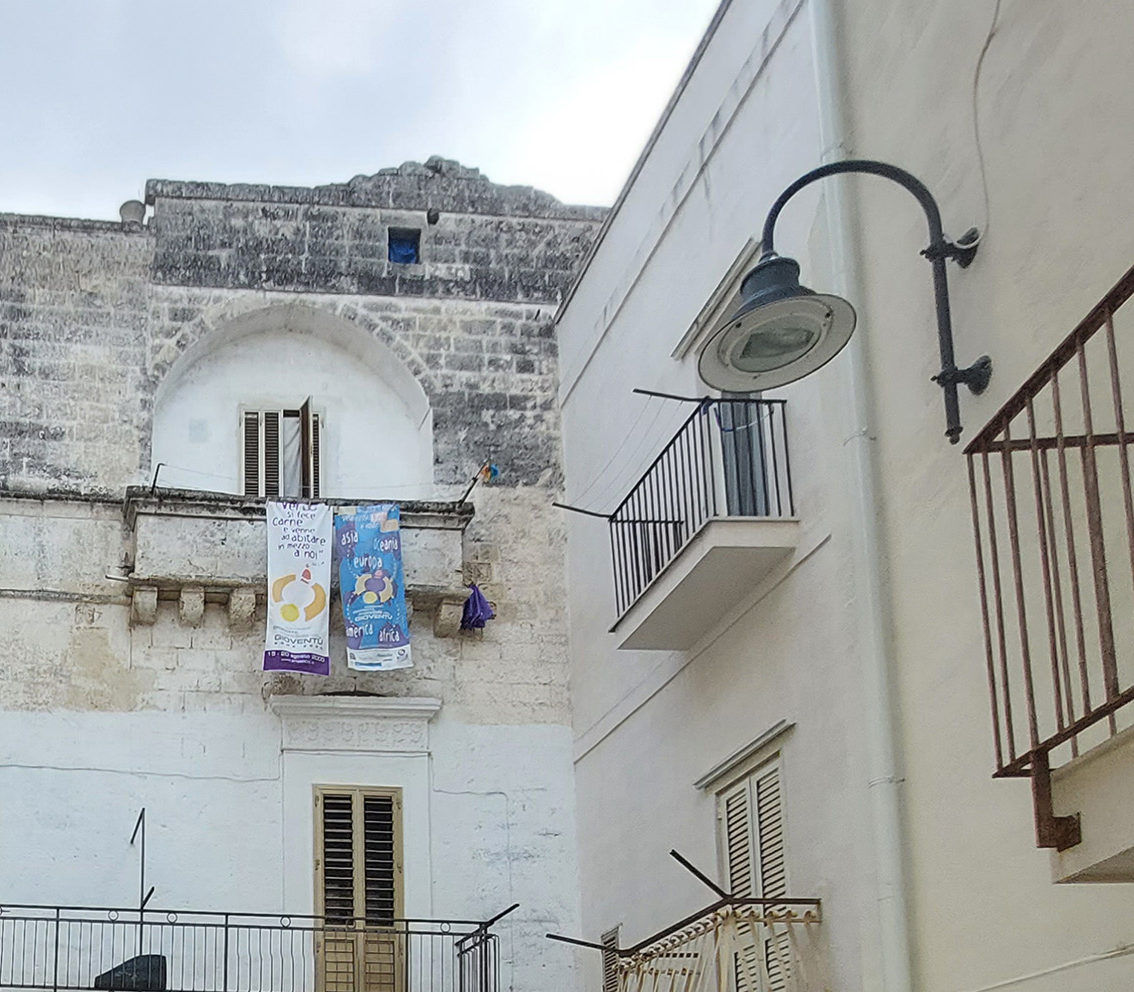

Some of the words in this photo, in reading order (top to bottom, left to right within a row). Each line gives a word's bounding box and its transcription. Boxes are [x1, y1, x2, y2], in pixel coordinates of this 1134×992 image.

[291, 534, 326, 546] abitare
[341, 530, 358, 546] asia
[294, 549, 300, 557] a
[353, 555, 382, 571] europa
[379, 628, 400, 642] africa
